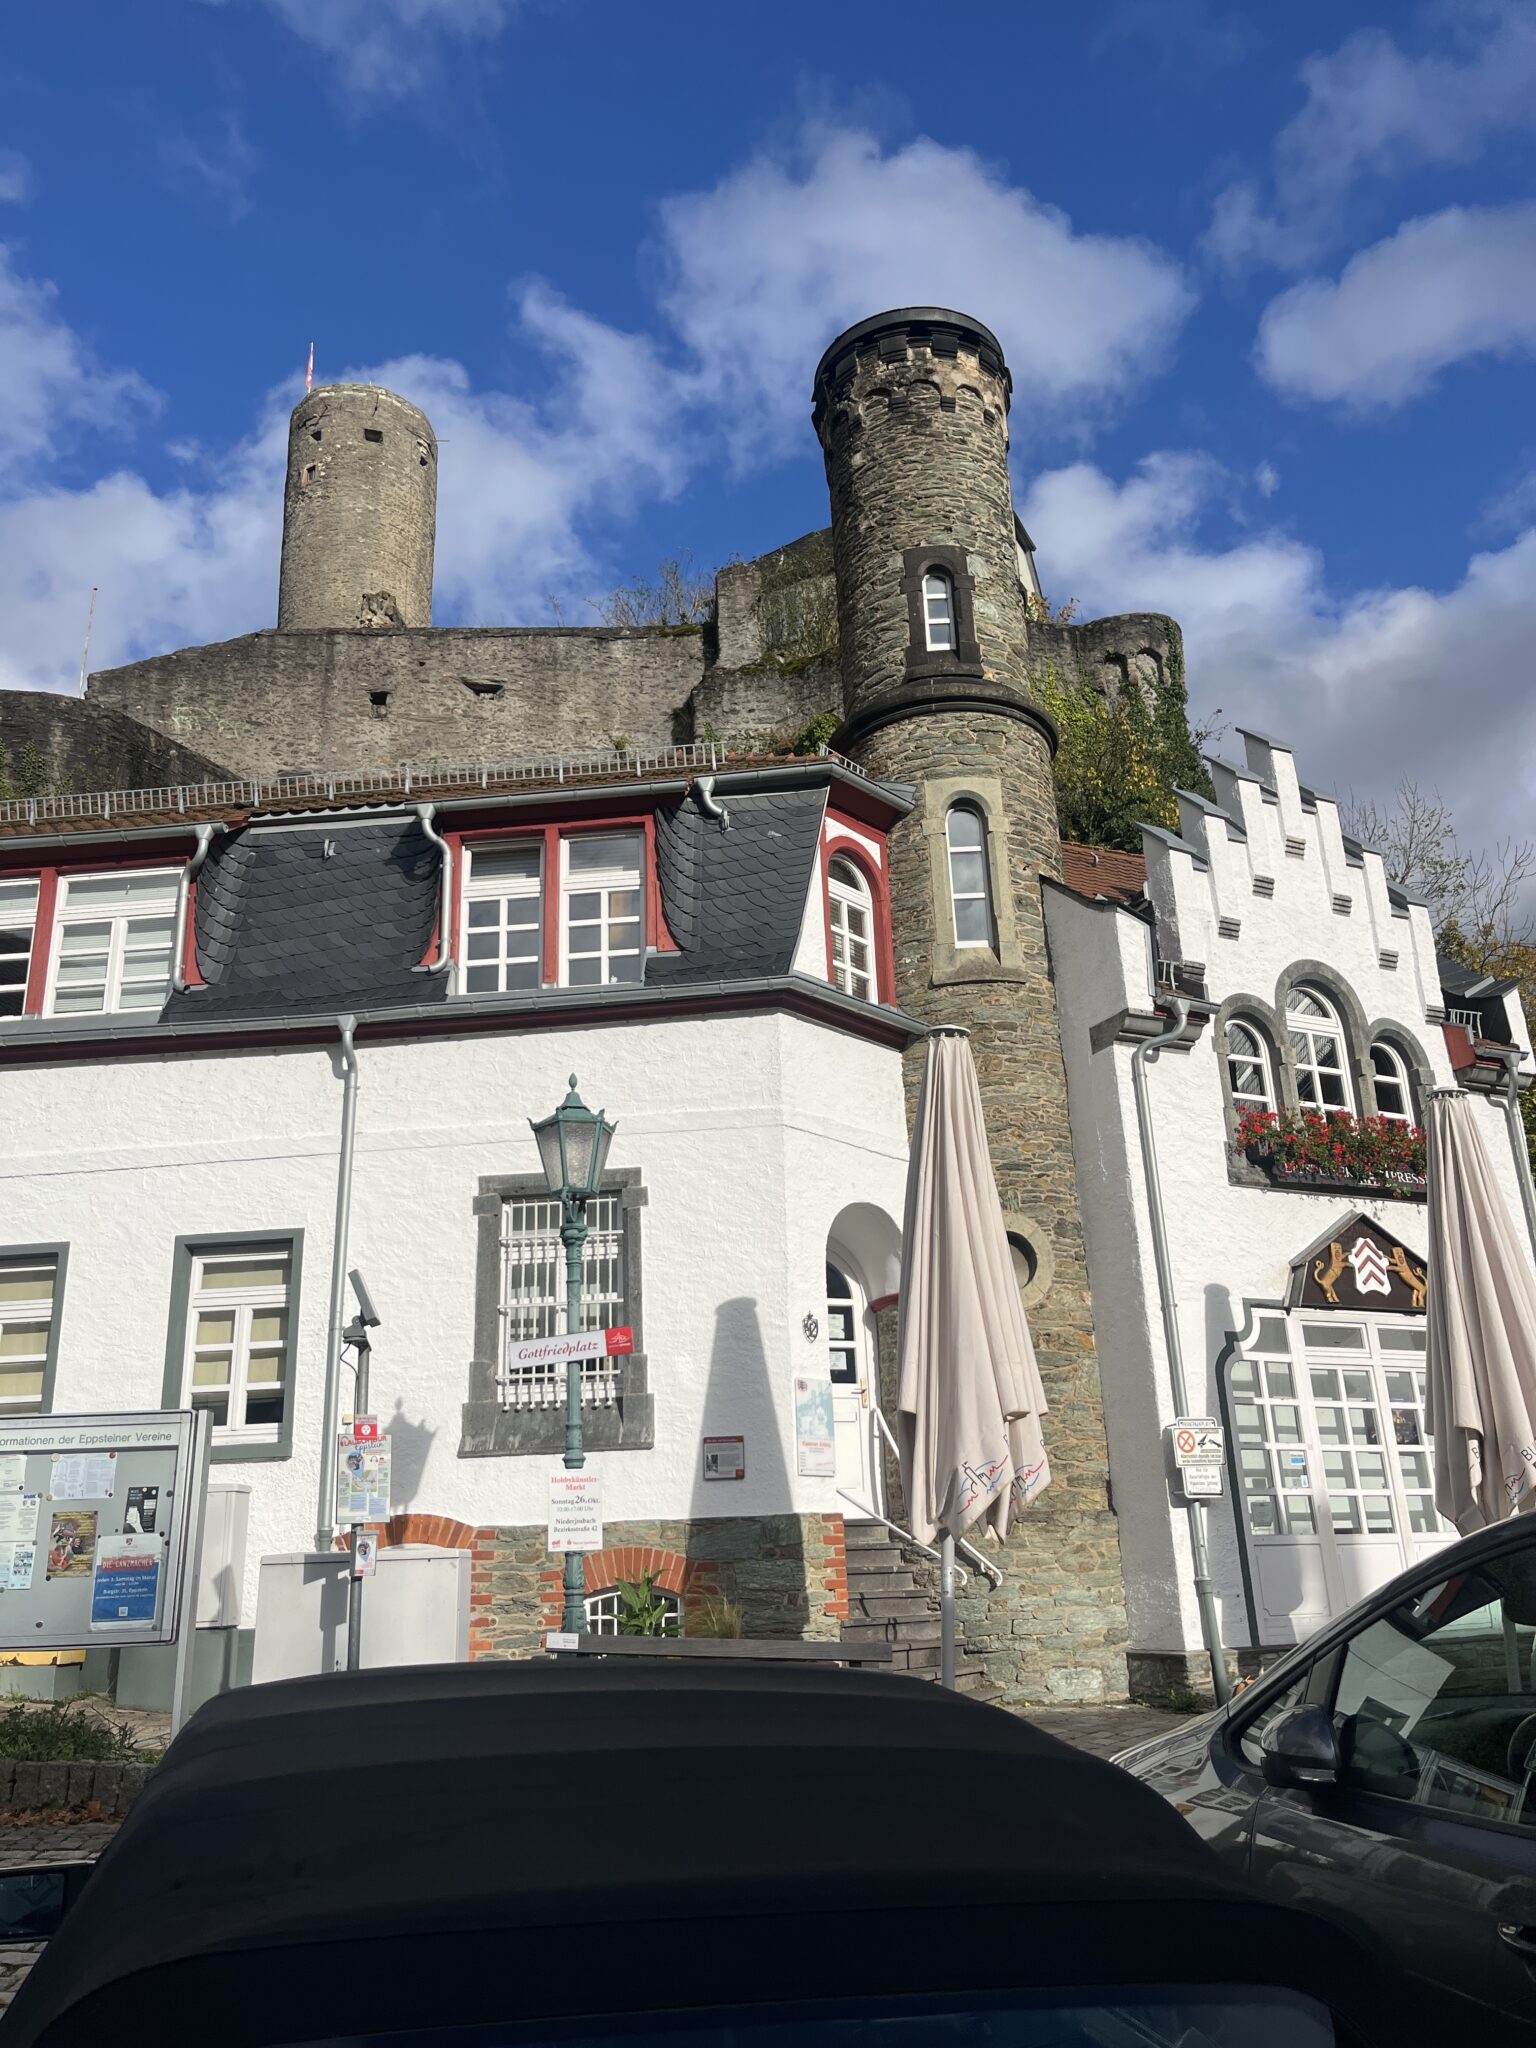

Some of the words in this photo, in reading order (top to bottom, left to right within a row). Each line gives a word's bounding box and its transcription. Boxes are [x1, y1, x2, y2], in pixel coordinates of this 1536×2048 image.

[518, 1340, 598, 1360] Gottfriedplatz
[58, 1435, 75, 1445] der
[79, 1433, 132, 1444] Eppsteiner
[136, 1432, 172, 1441] Vereine
[102, 1560, 113, 1569] DIE
